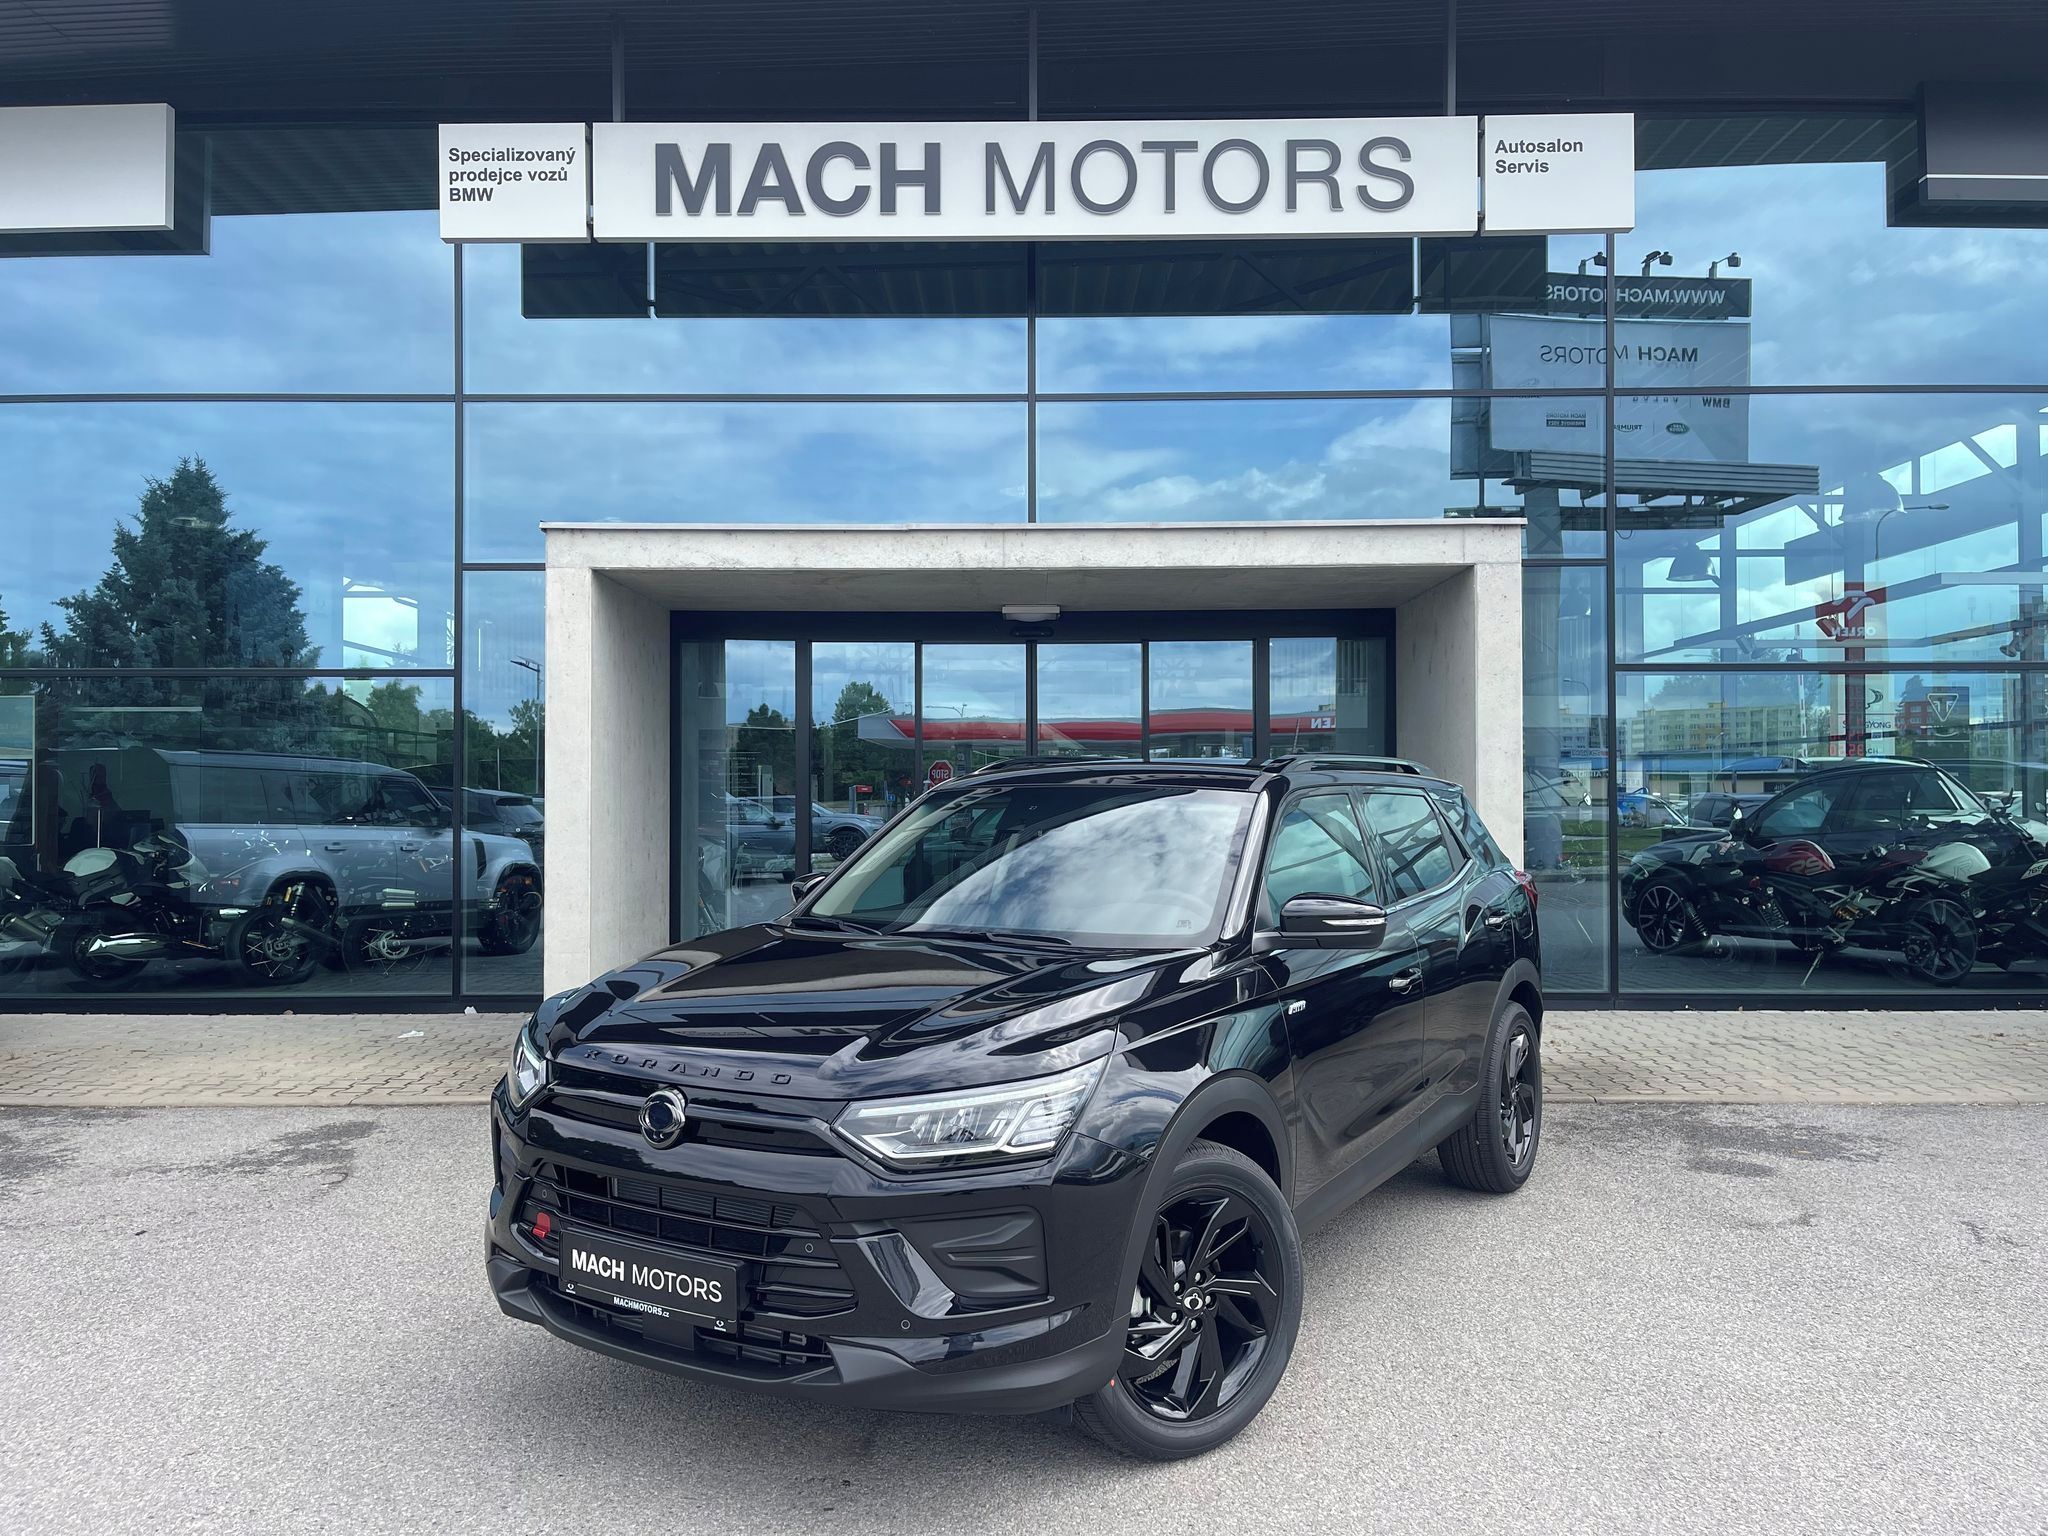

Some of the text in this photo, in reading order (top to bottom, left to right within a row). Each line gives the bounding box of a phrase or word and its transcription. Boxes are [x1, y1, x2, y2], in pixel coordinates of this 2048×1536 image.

[1495, 138, 1583, 154] Autosalon
[449, 147, 576, 165] Specializovaný
[1495, 159, 1550, 174] Servis
[449, 167, 568, 185] prodejce vozů
[654, 137, 1416, 217] MACH MOTORS
[449, 187, 494, 202] BMW
[584, 1049, 792, 1084] KORANDO
[572, 1249, 723, 1303] MACH MOTORS
[613, 1296, 670, 1318] MACHMOTORS.cz
